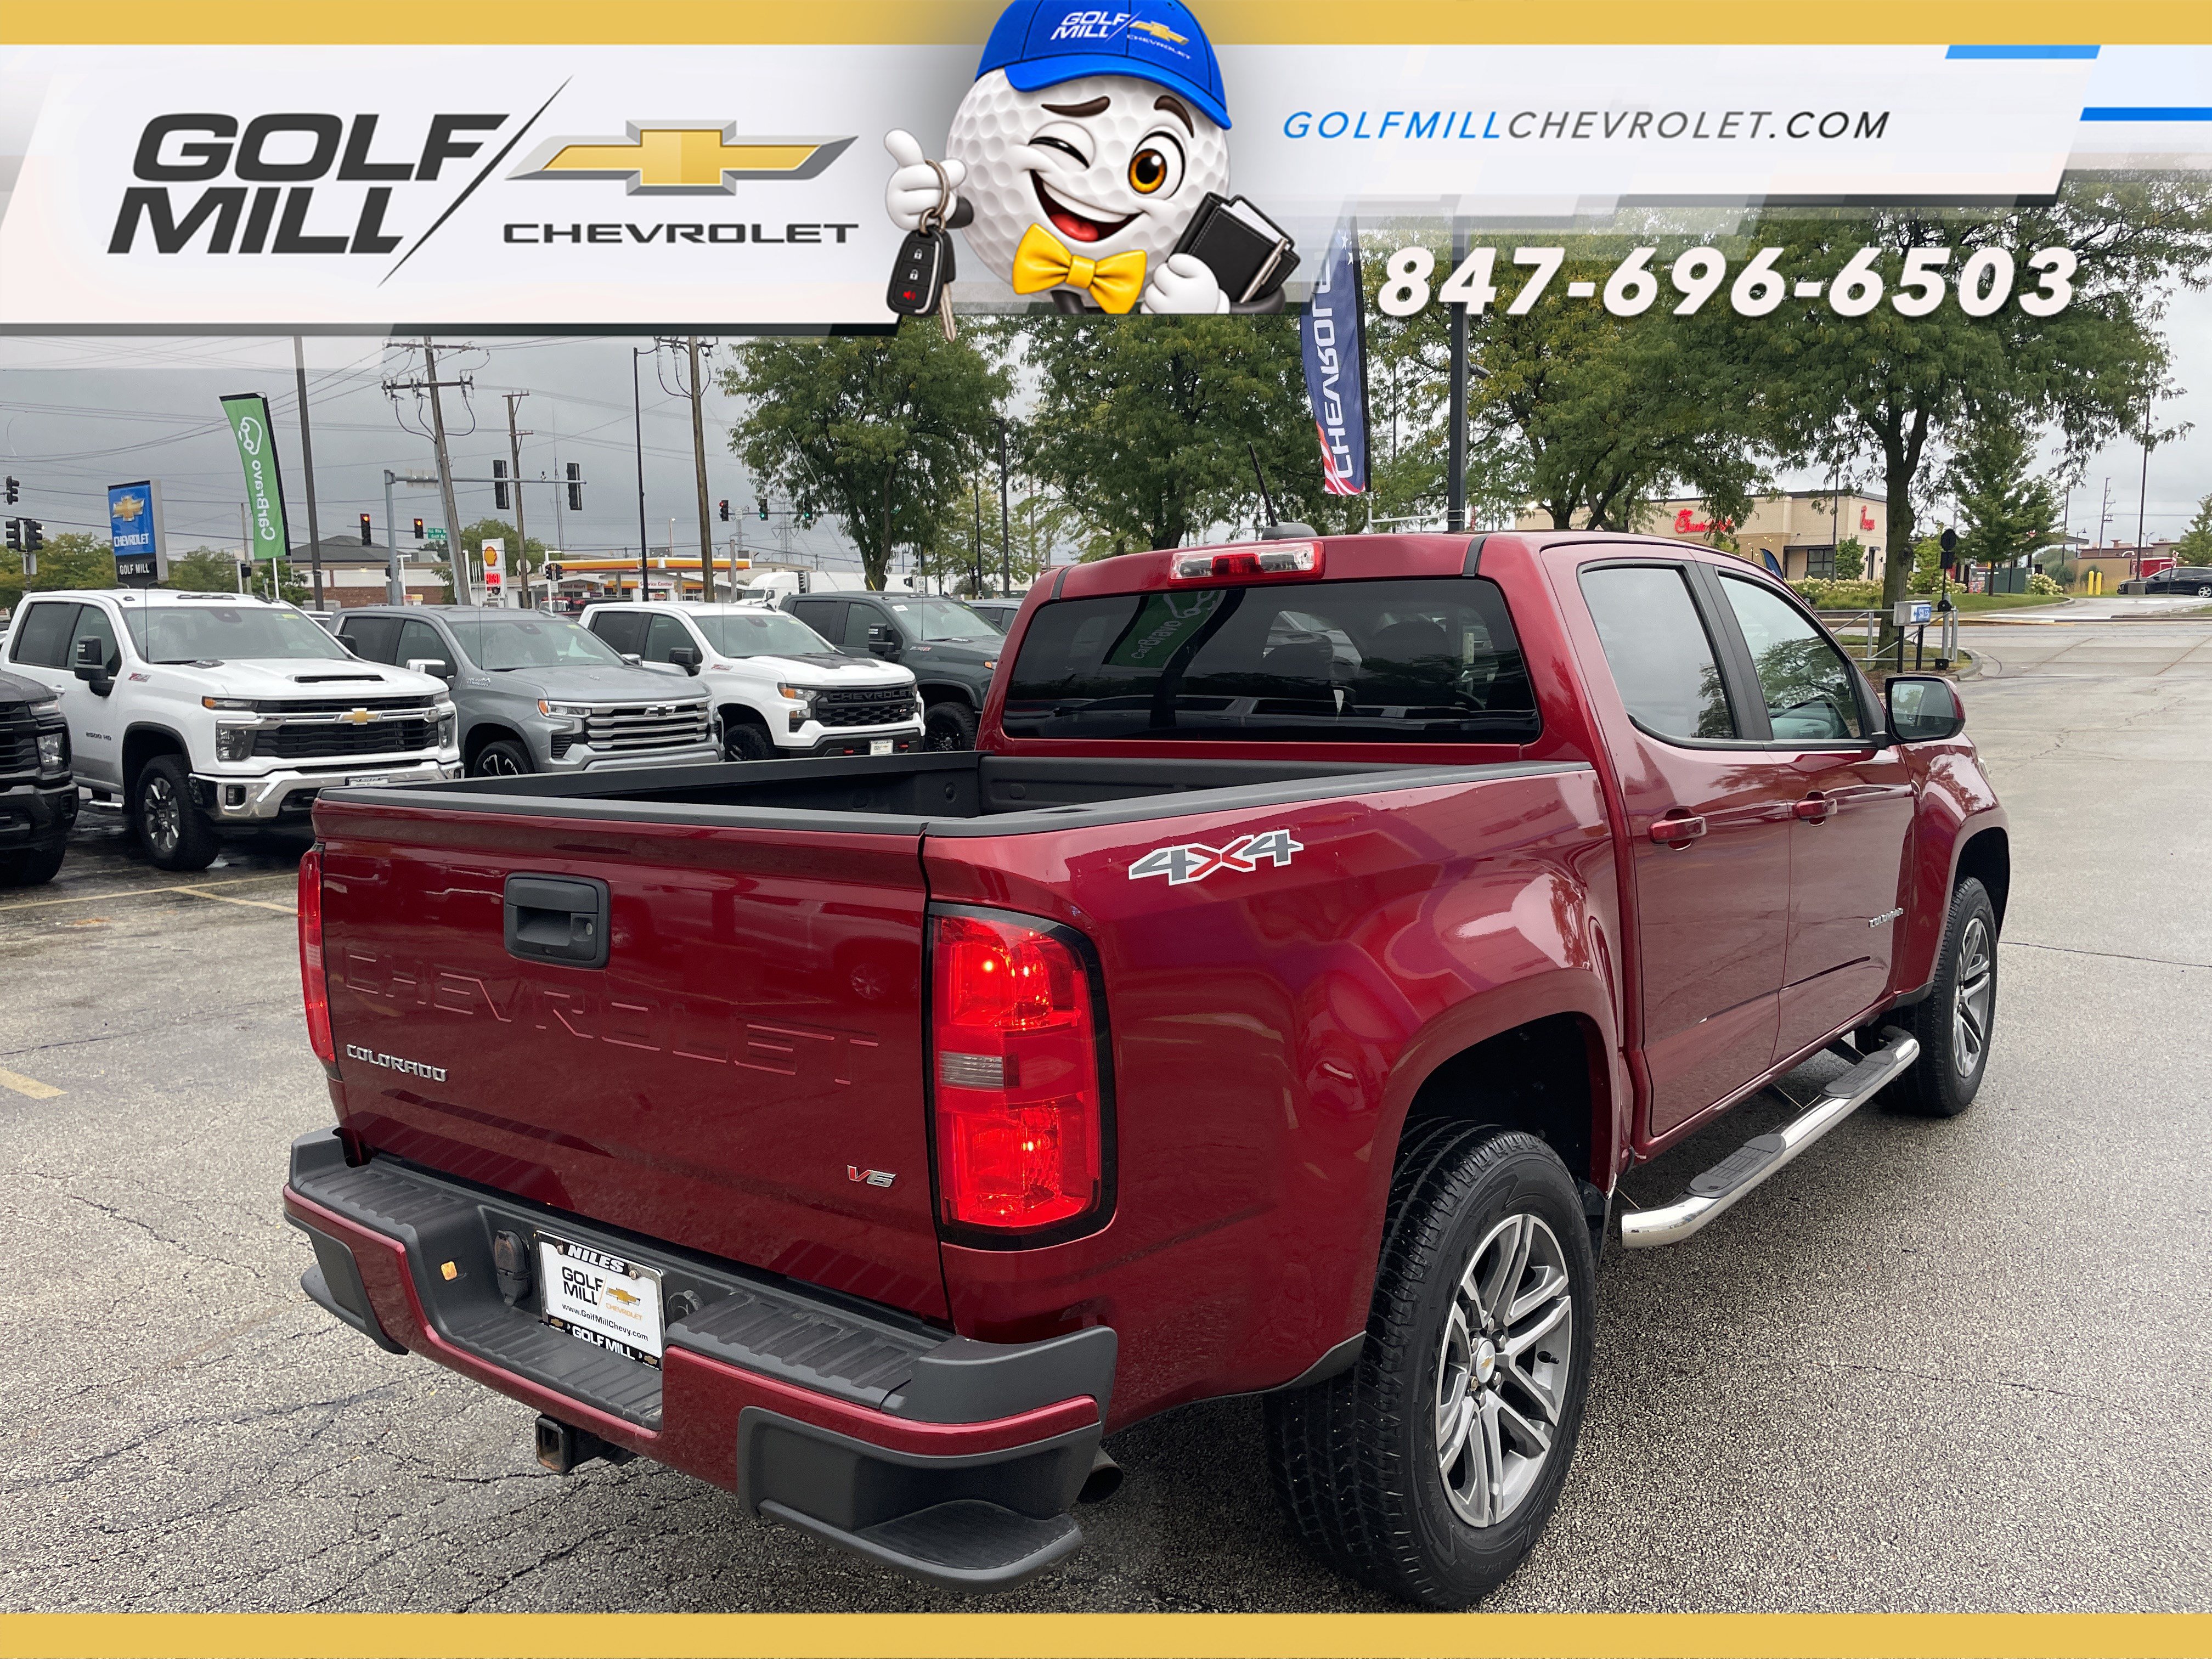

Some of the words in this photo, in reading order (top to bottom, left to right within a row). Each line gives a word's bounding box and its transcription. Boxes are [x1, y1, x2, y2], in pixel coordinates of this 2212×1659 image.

[114, 533, 149, 548] CHEVROLET
[120, 564, 133, 575] GOLF
[135, 563, 150, 574] MILL
[346, 1044, 448, 1082] COLORADO
[847, 1164, 896, 1188] V6
[567, 1245, 624, 1273] NILES
[562, 1266, 603, 1291] GOLF
[563, 1280, 597, 1306] MILL
[562, 1303, 648, 1341] www.GolfMillChevy.com
[606, 1303, 642, 1321] CHEVROLET
[572, 1325, 605, 1347] GOLF
[605, 1338, 635, 1361] MILL
